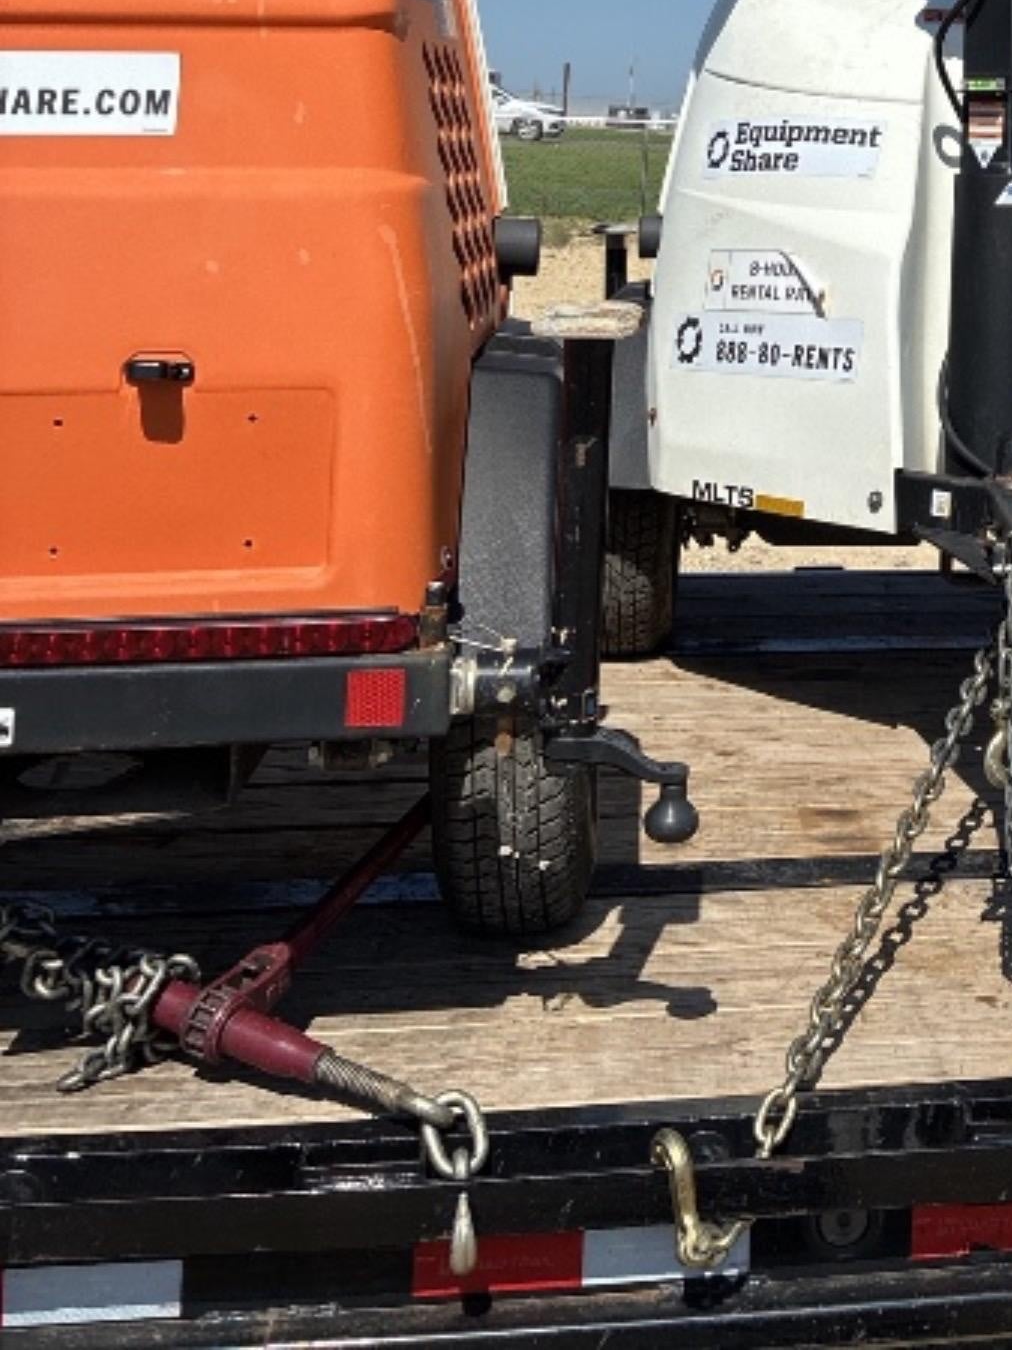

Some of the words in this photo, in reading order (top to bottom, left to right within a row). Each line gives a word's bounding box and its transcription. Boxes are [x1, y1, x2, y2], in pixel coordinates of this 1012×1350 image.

[734, 119, 883, 148] Equipment
[729, 149, 799, 172] Share
[731, 284, 780, 301] RENTAL
[715, 337, 857, 373] 888-80-RENTS
[691, 479, 755, 508] MLTS
